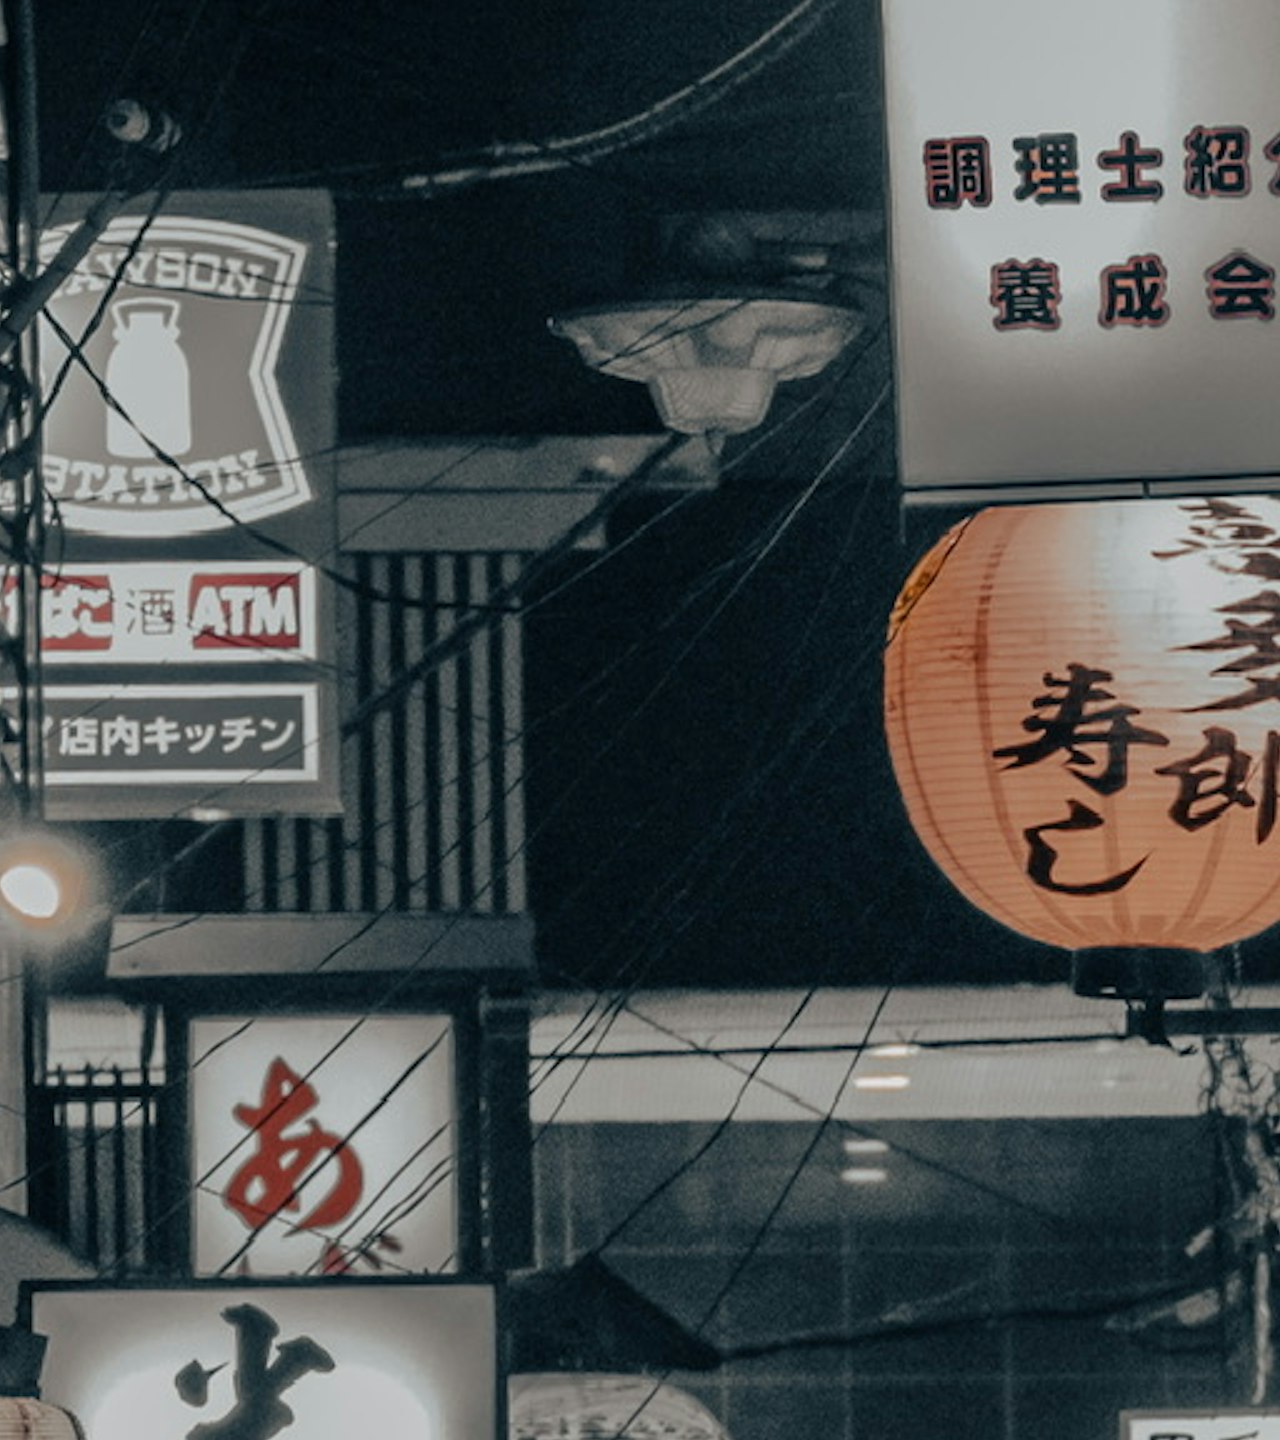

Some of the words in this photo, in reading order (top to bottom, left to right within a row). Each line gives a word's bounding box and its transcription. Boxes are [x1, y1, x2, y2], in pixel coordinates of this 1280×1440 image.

[58, 246, 266, 300] AWSON
[990, 247, 1276, 332] 養成会
[123, 587, 176, 637] 酒
[188, 584, 299, 638] ATM
[58, 715, 297, 758] 店内キッチン
[222, 1053, 404, 1274] あ
